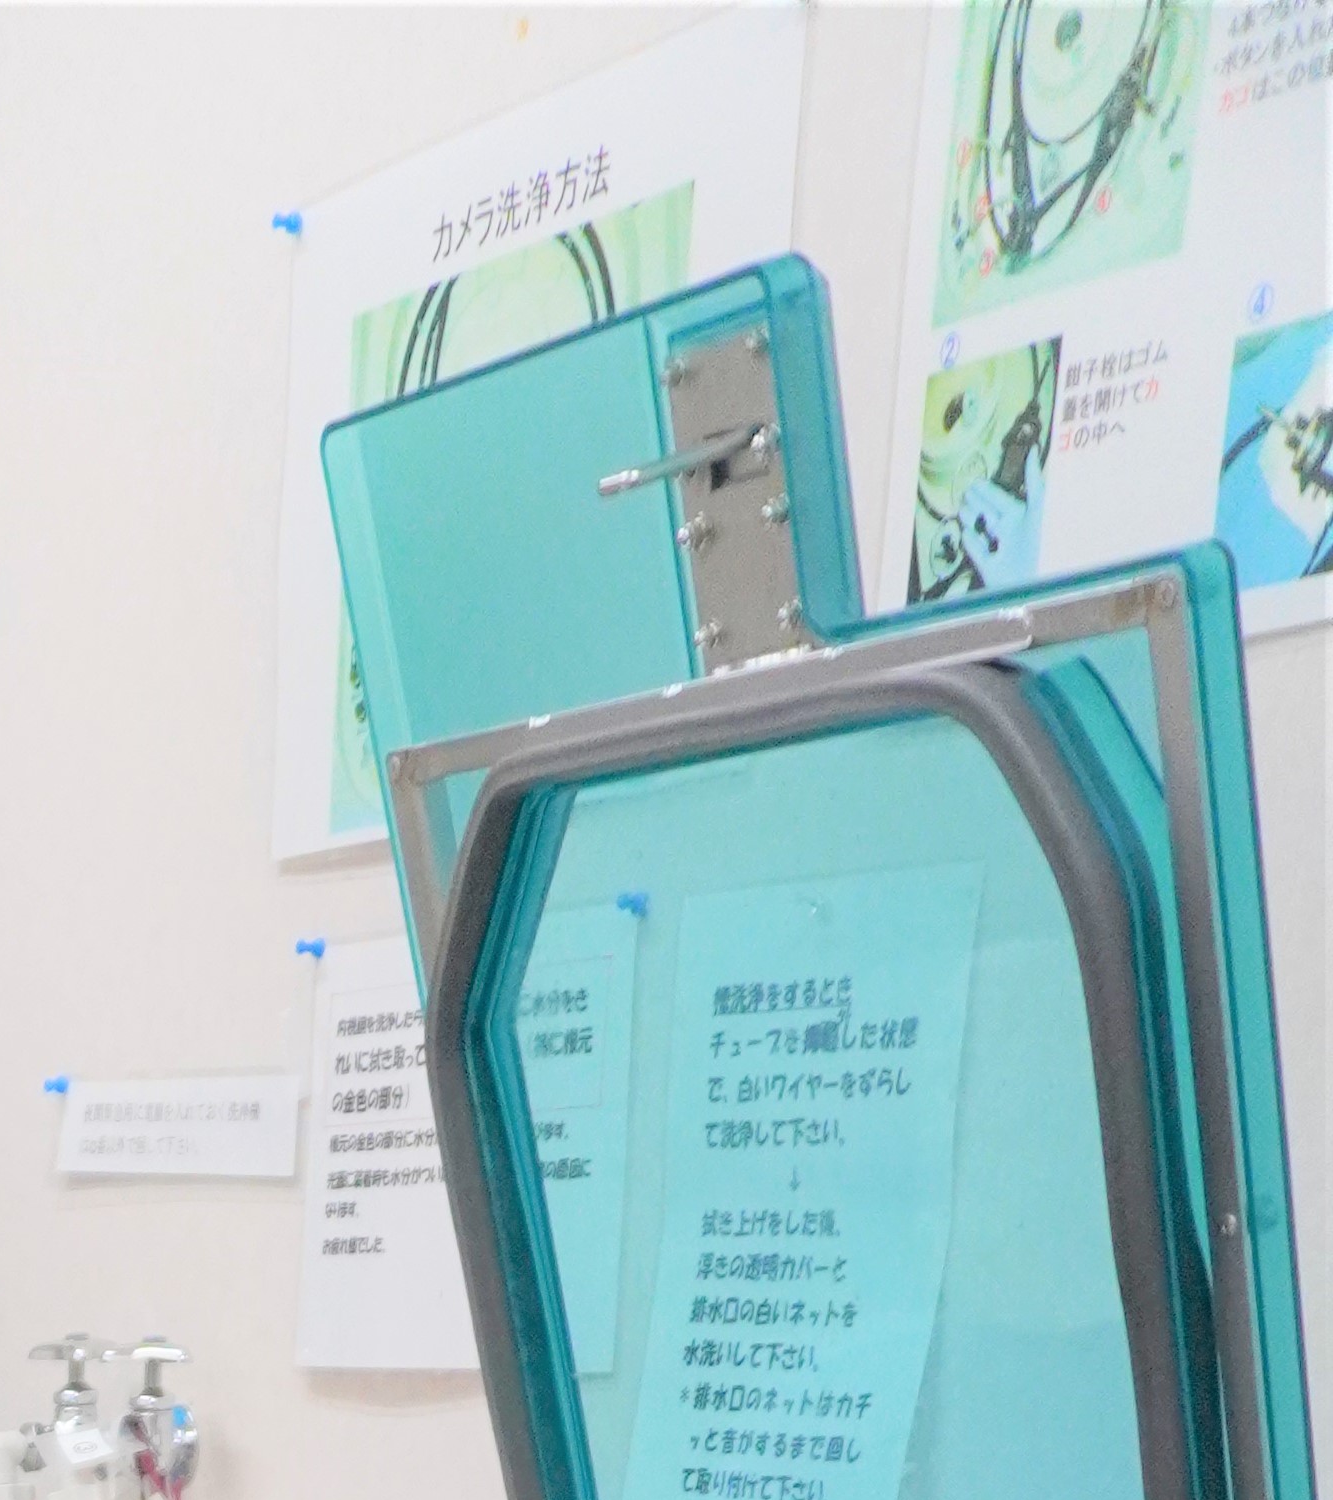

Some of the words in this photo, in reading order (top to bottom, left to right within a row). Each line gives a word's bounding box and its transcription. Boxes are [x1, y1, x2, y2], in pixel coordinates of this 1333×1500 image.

[432, 144, 611, 263] カメラ洗浄方法
